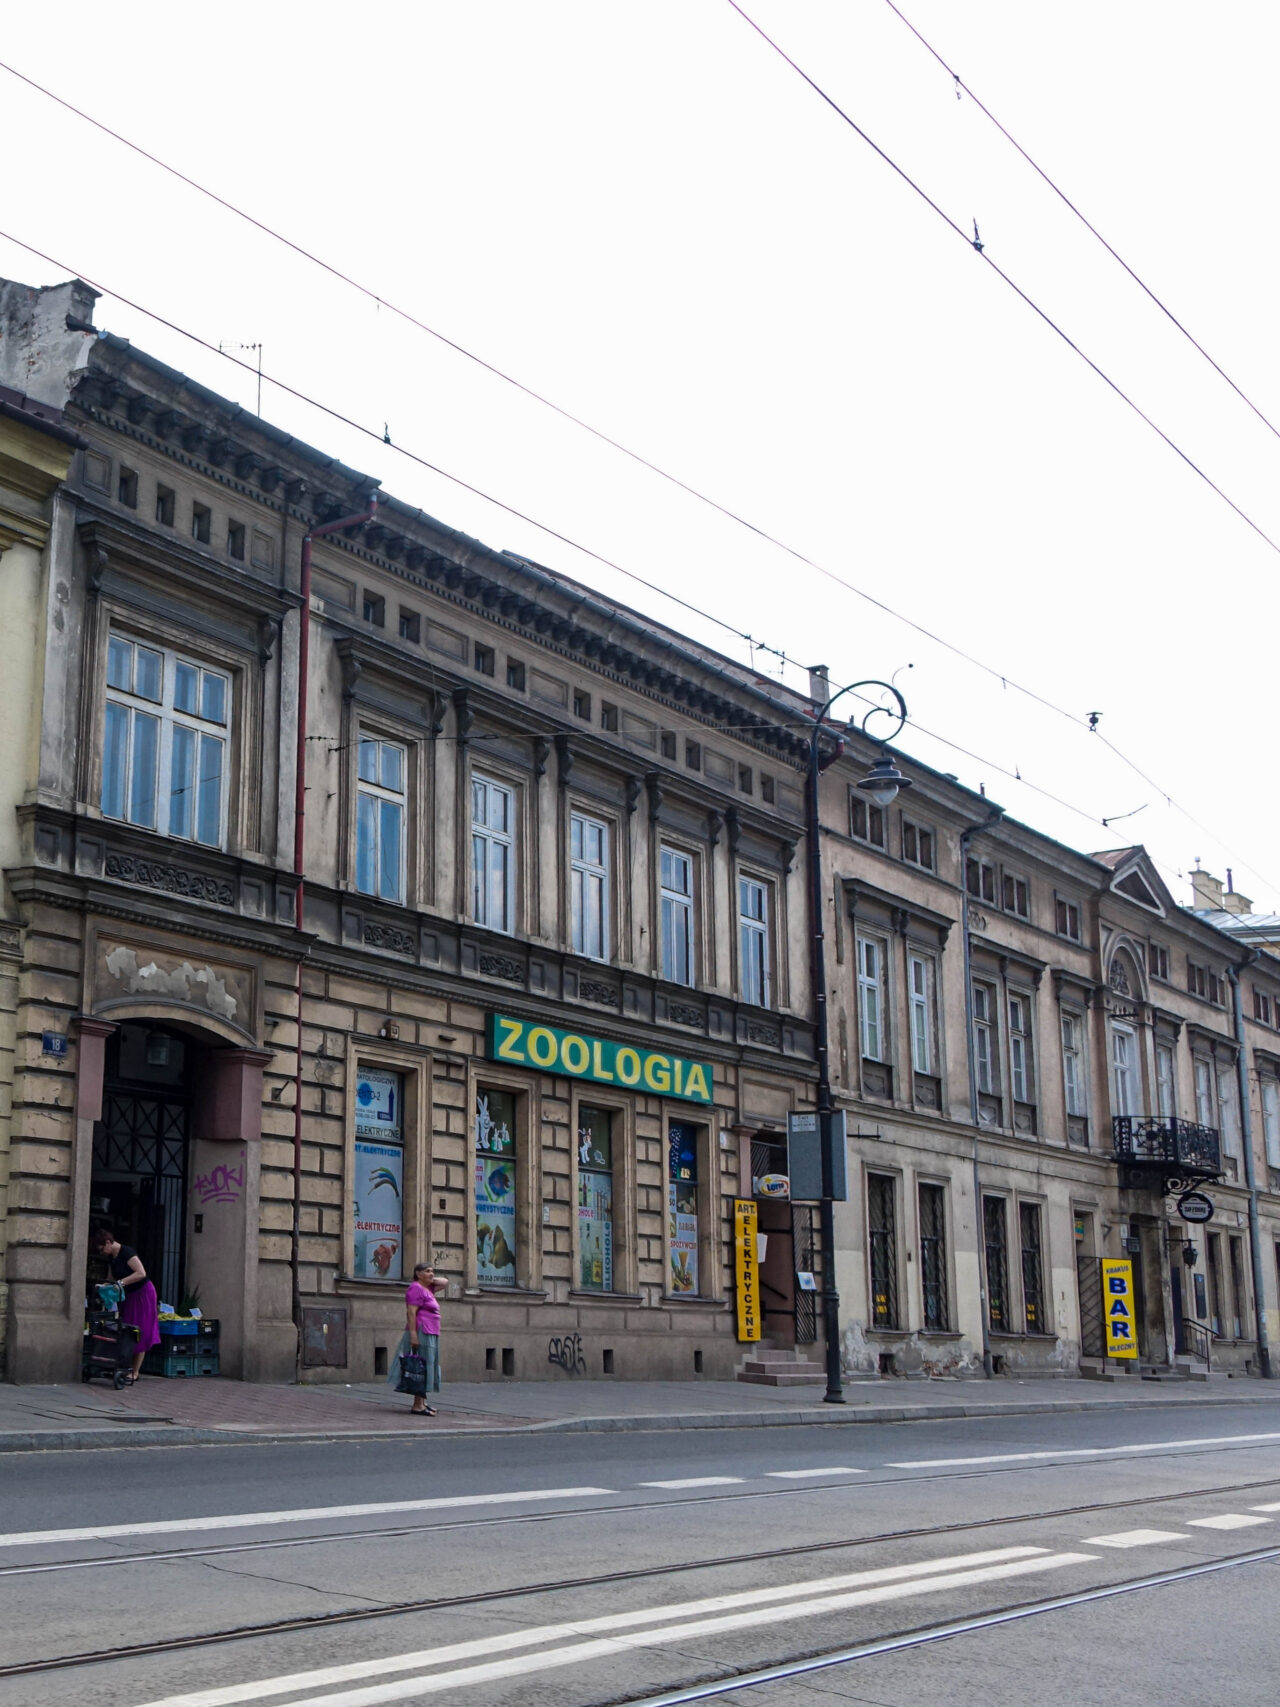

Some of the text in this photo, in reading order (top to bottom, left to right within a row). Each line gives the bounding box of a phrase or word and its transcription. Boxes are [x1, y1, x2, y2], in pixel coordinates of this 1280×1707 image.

[52, 1038, 61, 1051] 18
[498, 1018, 711, 1101] ZOOLOGIA
[766, 1182, 785, 1192] LOTTO
[737, 1203, 756, 1214] ART.
[743, 1215, 754, 1338] ELEKTRYCZNE
[1108, 1276, 1132, 1340] BAR
[1109, 1342, 1136, 1353] MLECZNY
